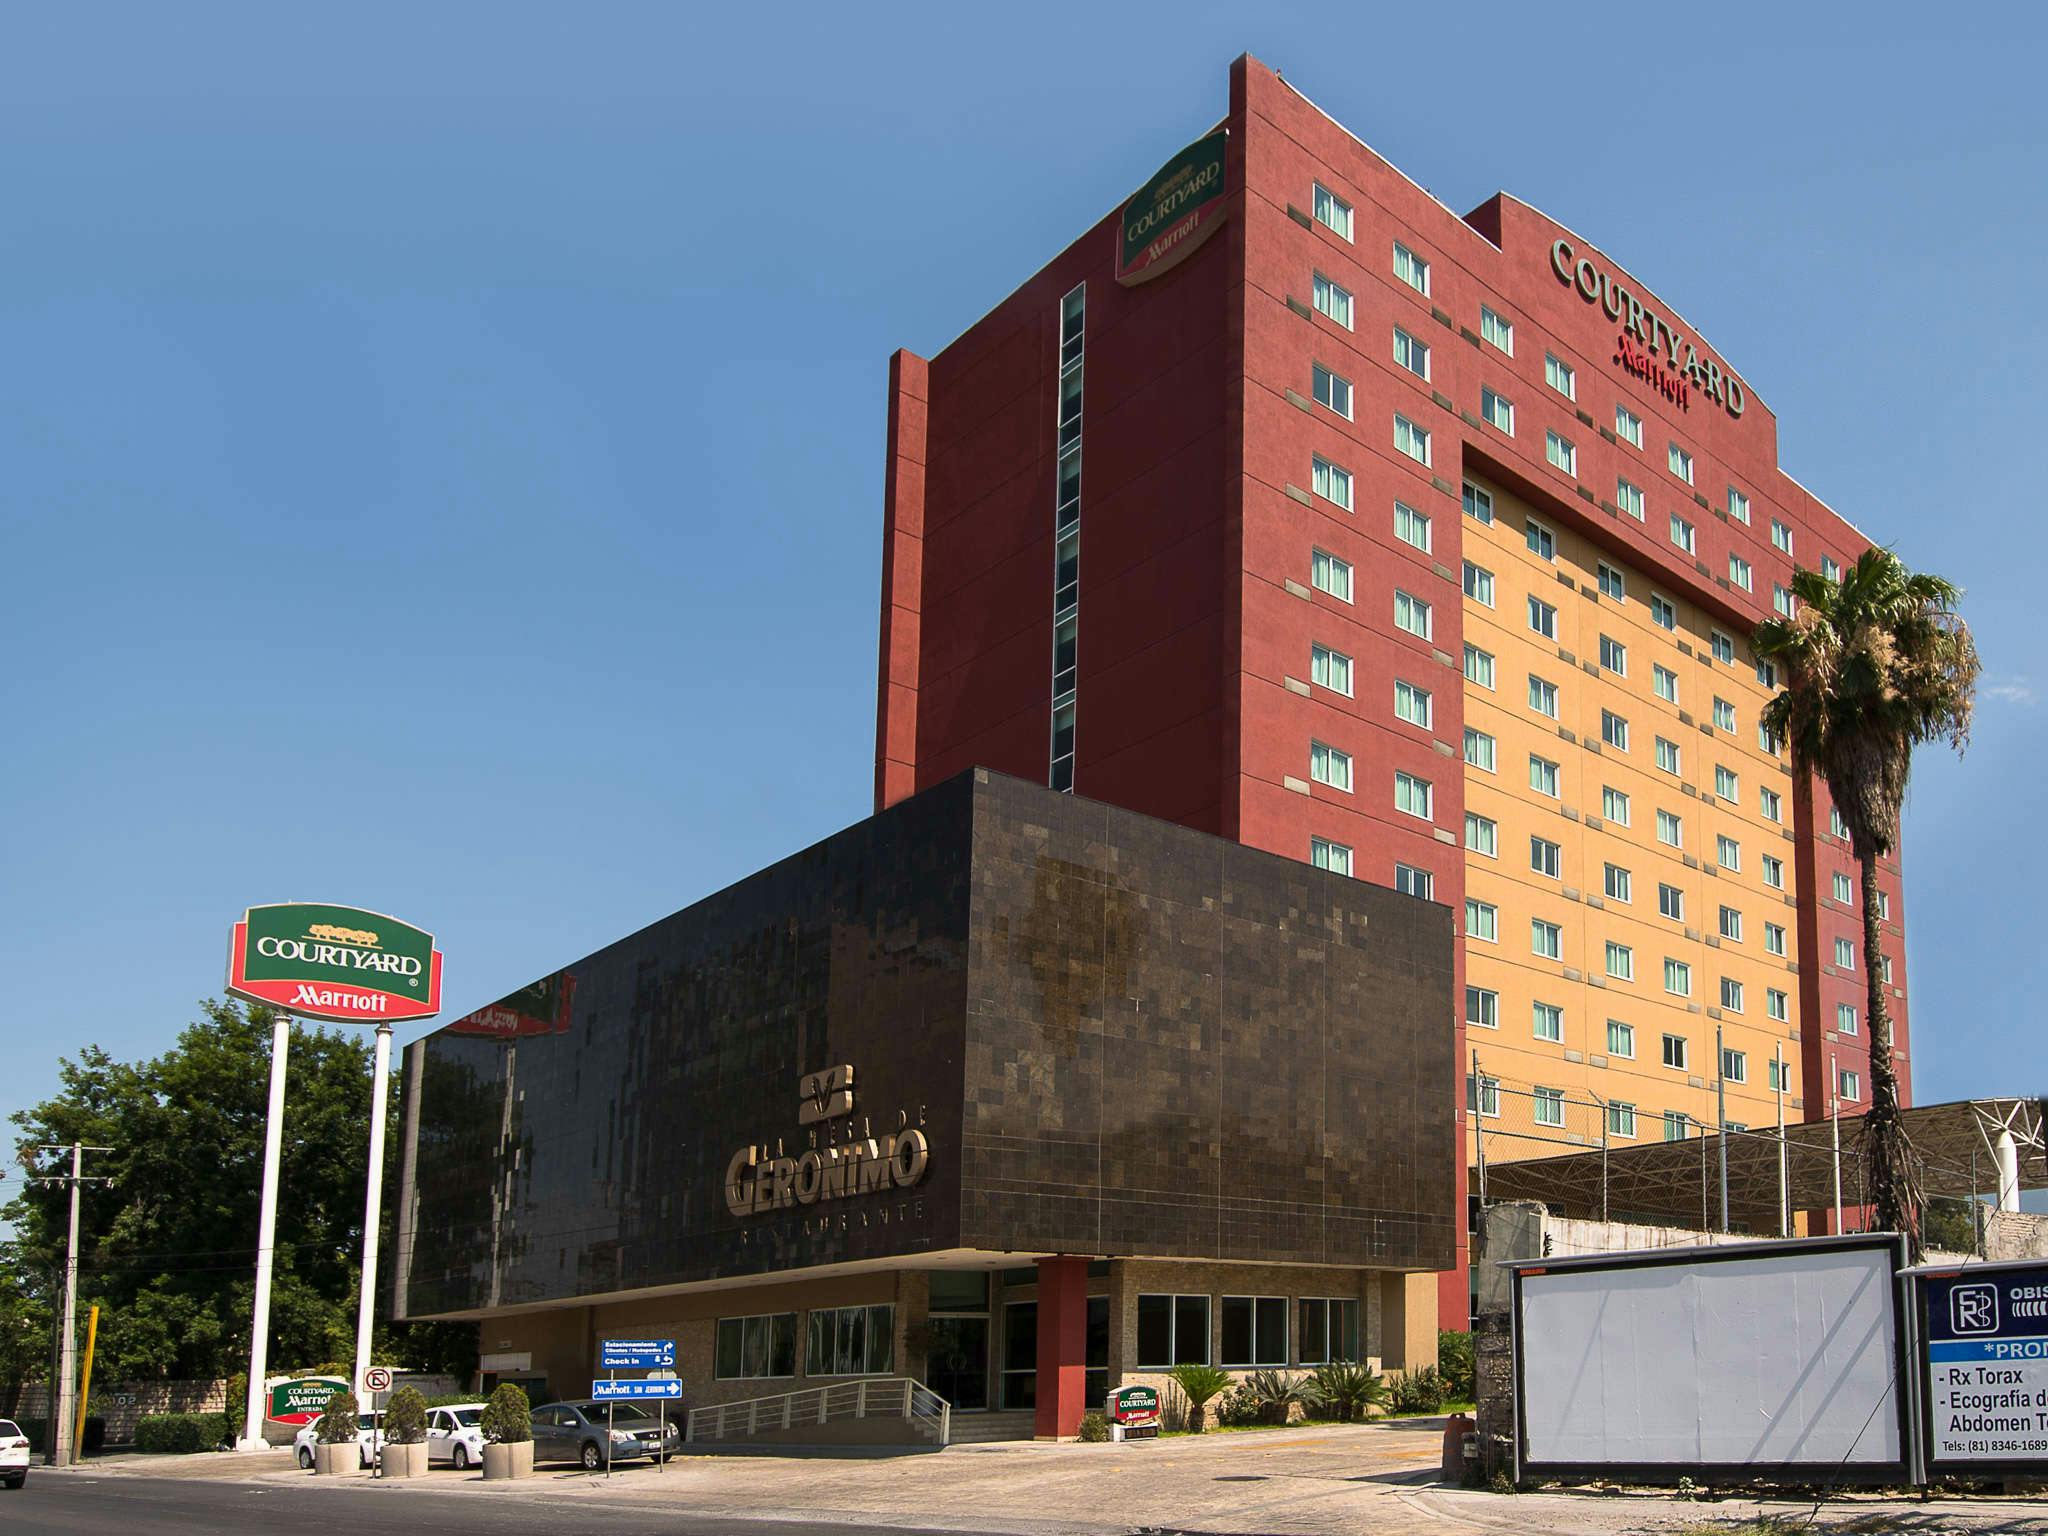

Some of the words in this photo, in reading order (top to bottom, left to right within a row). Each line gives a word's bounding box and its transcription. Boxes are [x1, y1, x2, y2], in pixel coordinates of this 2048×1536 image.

[1128, 161, 1220, 242] COURTYARD
[1145, 211, 1199, 267] Marriott
[1551, 239, 1745, 418] COURTYARD
[1613, 334, 1691, 413] Marriott
[257, 936, 422, 976] COURTYARD
[289, 983, 388, 1012] Marriott
[725, 1128, 929, 1217] GERONIMO
[1949, 1368, 1972, 1386] Rx
[1976, 1367, 2023, 1385] Torax
[285, 1394, 332, 1407] Marrio
[287, 1387, 335, 1395] COURTYARD
[594, 1385, 630, 1395] Marriott
[1950, 1389, 2031, 1412] Ecografía
[2036, 1388, 2048, 1408] d
[1120, 1399, 1156, 1408] COURTYARD
[1949, 1414, 2031, 1432] Abdomen
[2036, 1412, 2048, 1431] T
[1943, 1441, 1966, 1452] Tels:
[1968, 1440, 1989, 1453] (81)
[1991, 1440, 2048, 1452] 8346-1689
